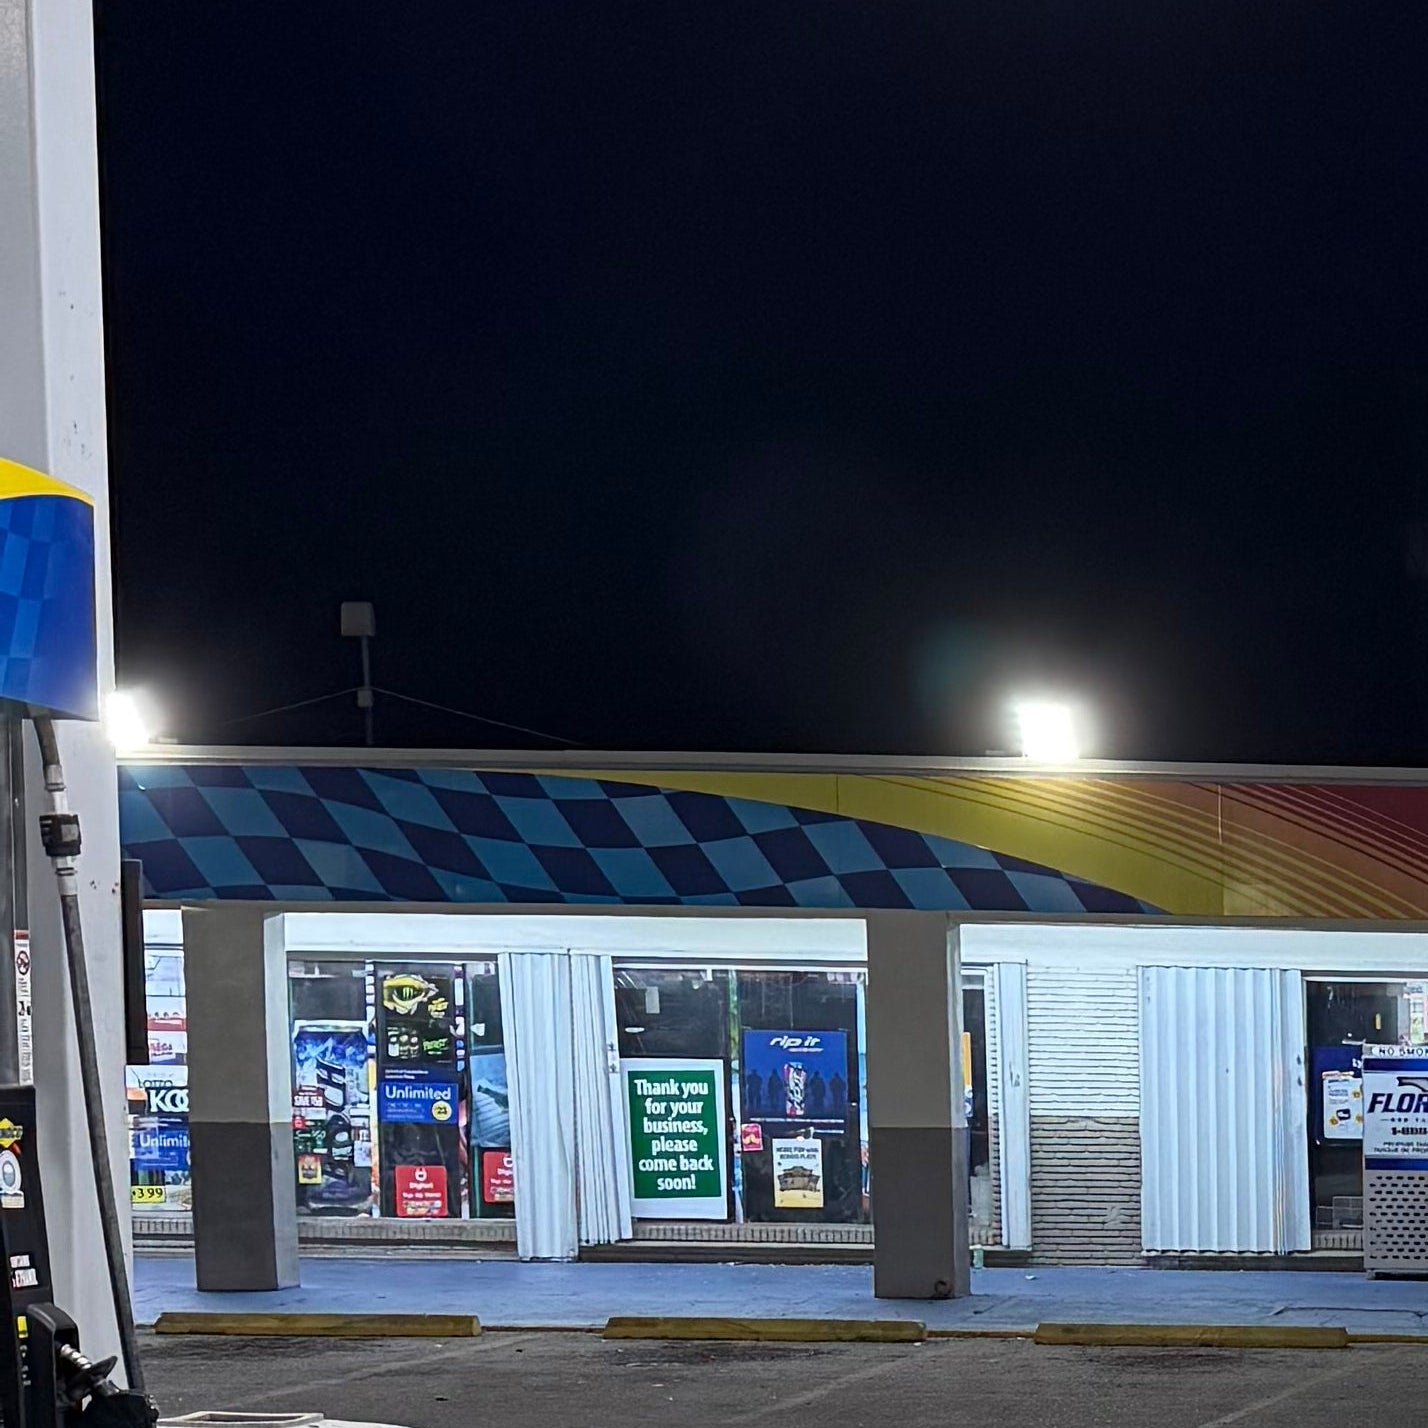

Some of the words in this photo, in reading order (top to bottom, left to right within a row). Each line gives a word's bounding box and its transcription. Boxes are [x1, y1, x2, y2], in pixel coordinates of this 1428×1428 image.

[1378, 1048, 1395, 1057] NO
[385, 1084, 451, 1100] Unlimited
[634, 1078, 680, 1096] Thank
[680, 1082, 709, 1099] you
[644, 1097, 667, 1115] for
[669, 1101, 704, 1118] your
[643, 1116, 708, 1136] business,
[139, 1133, 190, 1148] Unlimit
[651, 1135, 698, 1156] please
[638, 1158, 678, 1171] come
[679, 1154, 714, 1171] back
[657, 1173, 697, 1191] soon!
